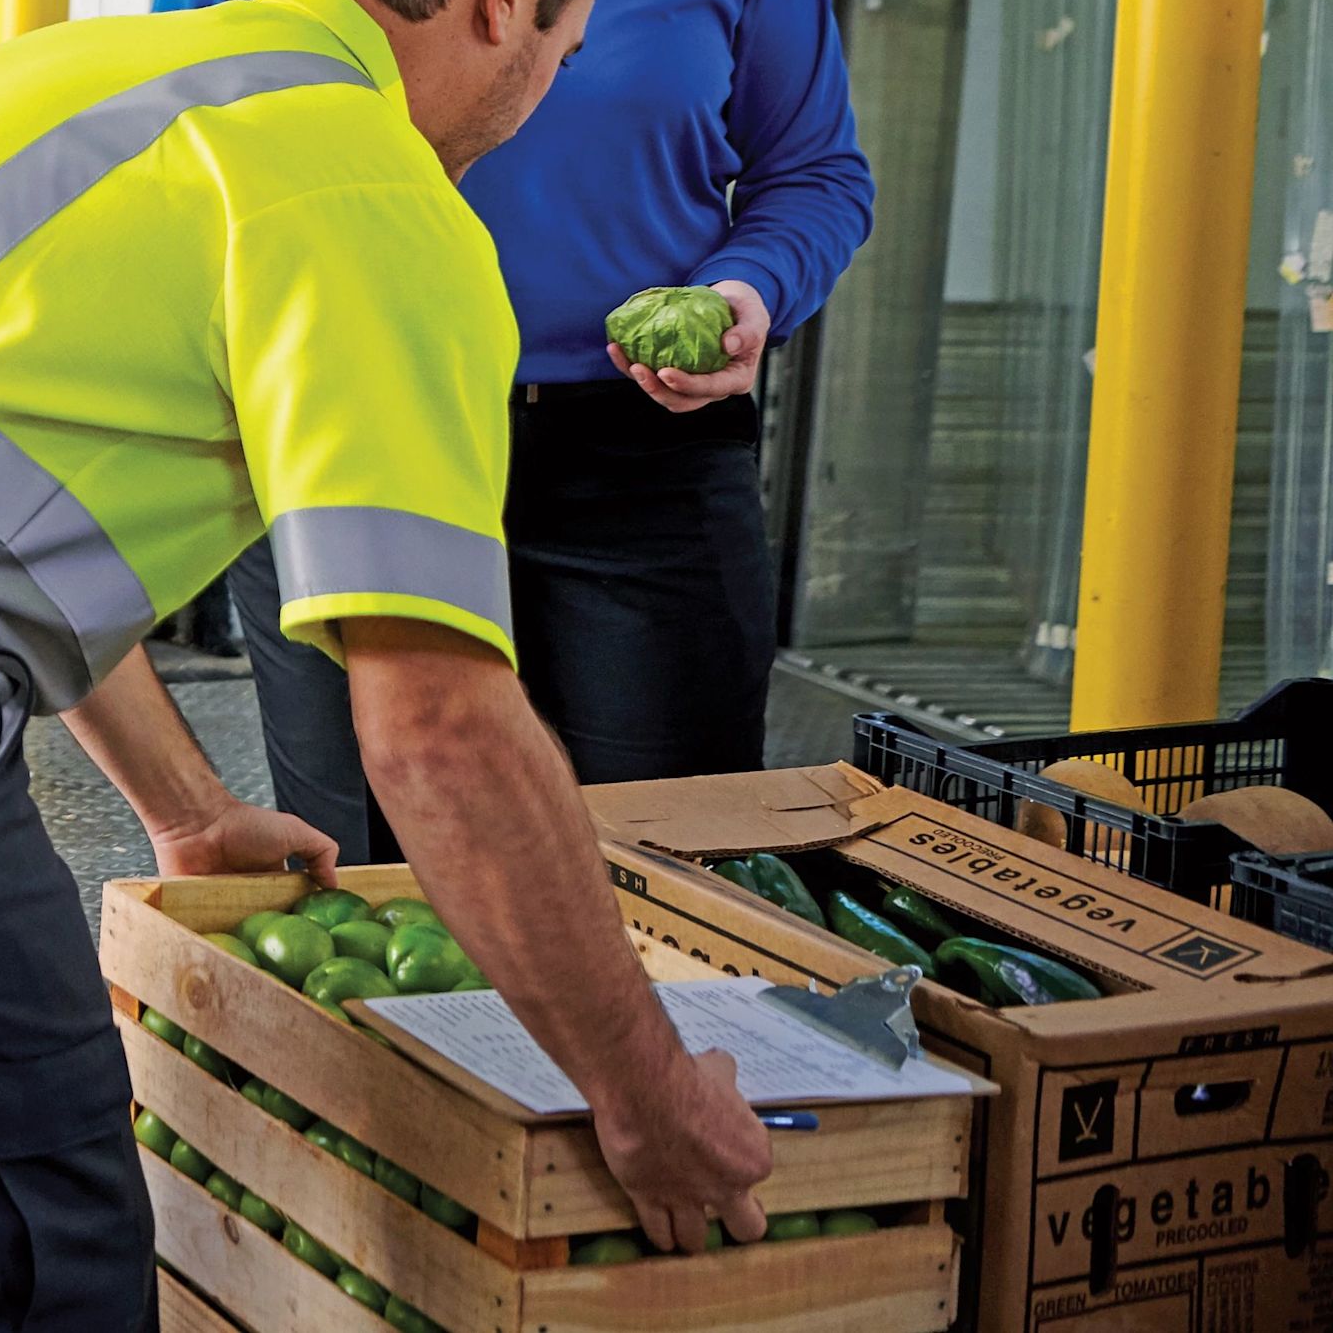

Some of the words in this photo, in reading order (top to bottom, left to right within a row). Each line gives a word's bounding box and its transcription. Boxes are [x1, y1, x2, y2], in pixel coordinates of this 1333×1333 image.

[933, 828, 1006, 860] PRECOOLED
[908, 831, 1137, 934] vegetables
[1184, 1030, 1275, 1053] FRESH
[1048, 1165, 1331, 1248] vegetabe
[1156, 1216, 1249, 1247] PRECOOLED
[1114, 1270, 1197, 1302] TOMATOES
[1035, 1292, 1087, 1317] GREEN
